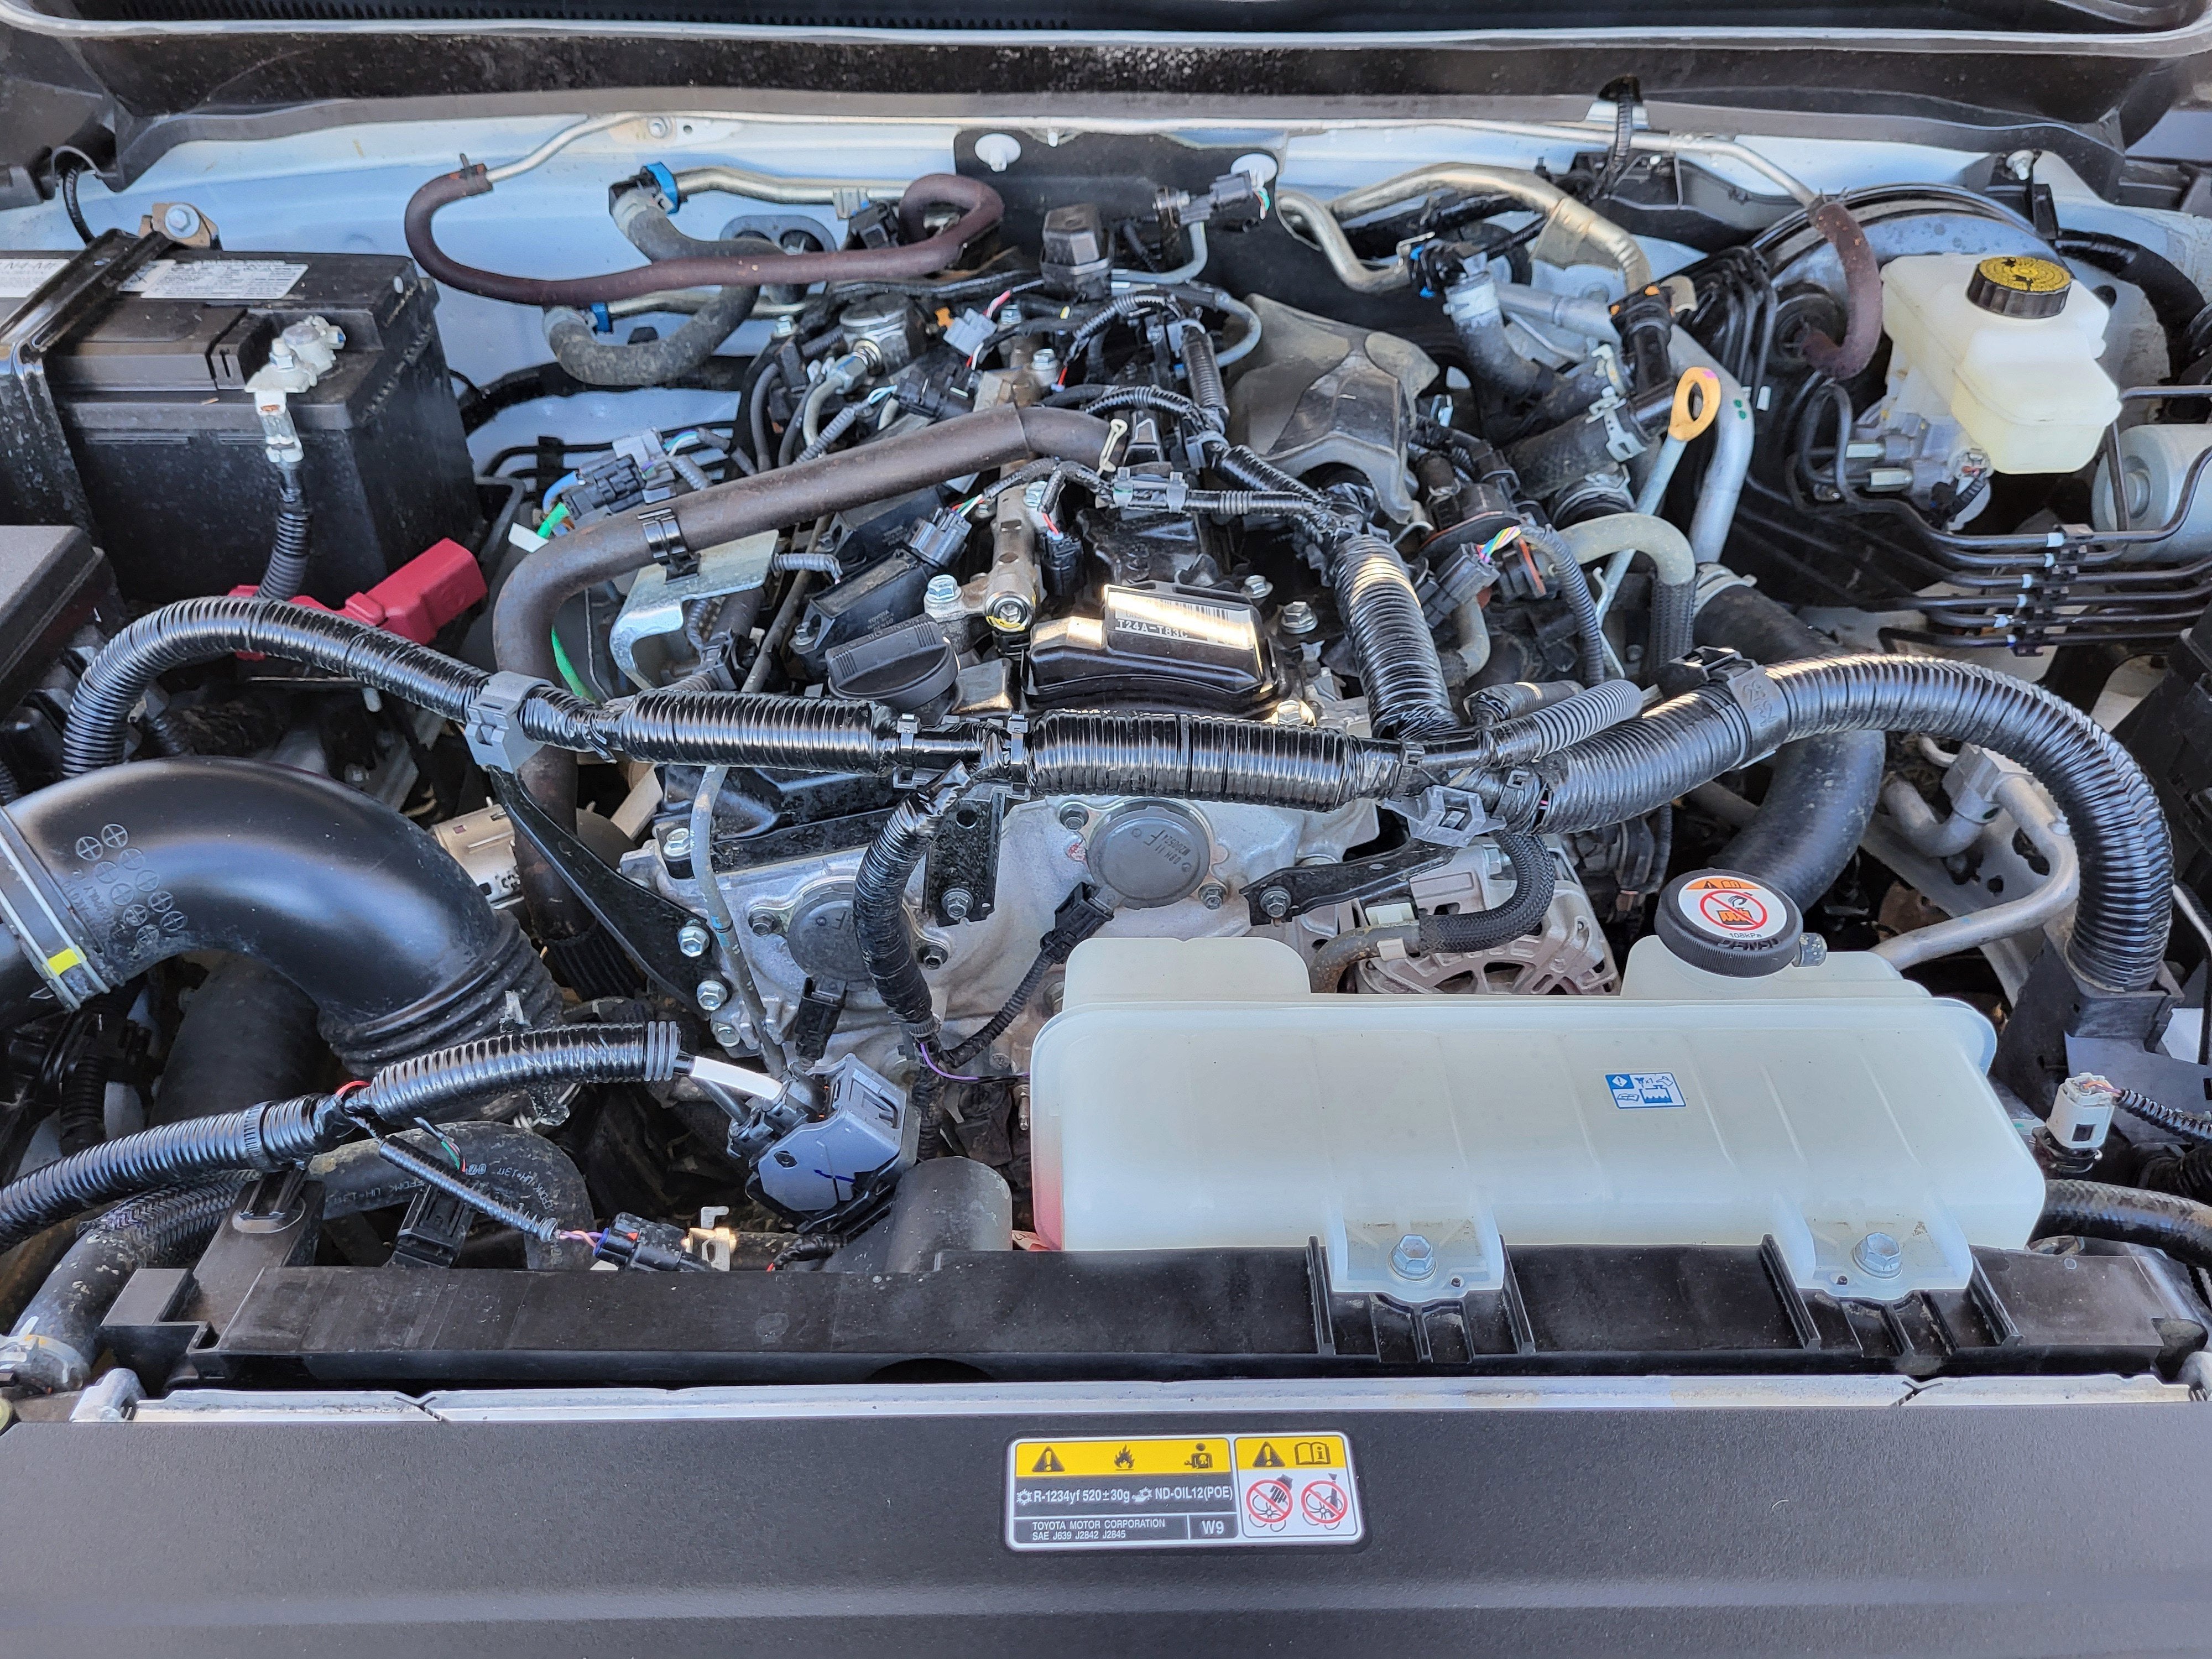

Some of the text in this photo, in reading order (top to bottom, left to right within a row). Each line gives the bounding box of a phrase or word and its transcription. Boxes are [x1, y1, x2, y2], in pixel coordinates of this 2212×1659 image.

[1117, 618, 1188, 639] T24A-T83C
[1034, 1486, 1233, 1505] R-1234yf 520±30g ND-OIL12(POE)
[1032, 1519, 1165, 1530] TOYOTA MOTOR CORPORATION
[1202, 1520, 1224, 1535] W9
[1032, 1530, 1126, 1541] SAE J639 J2842 J2845
